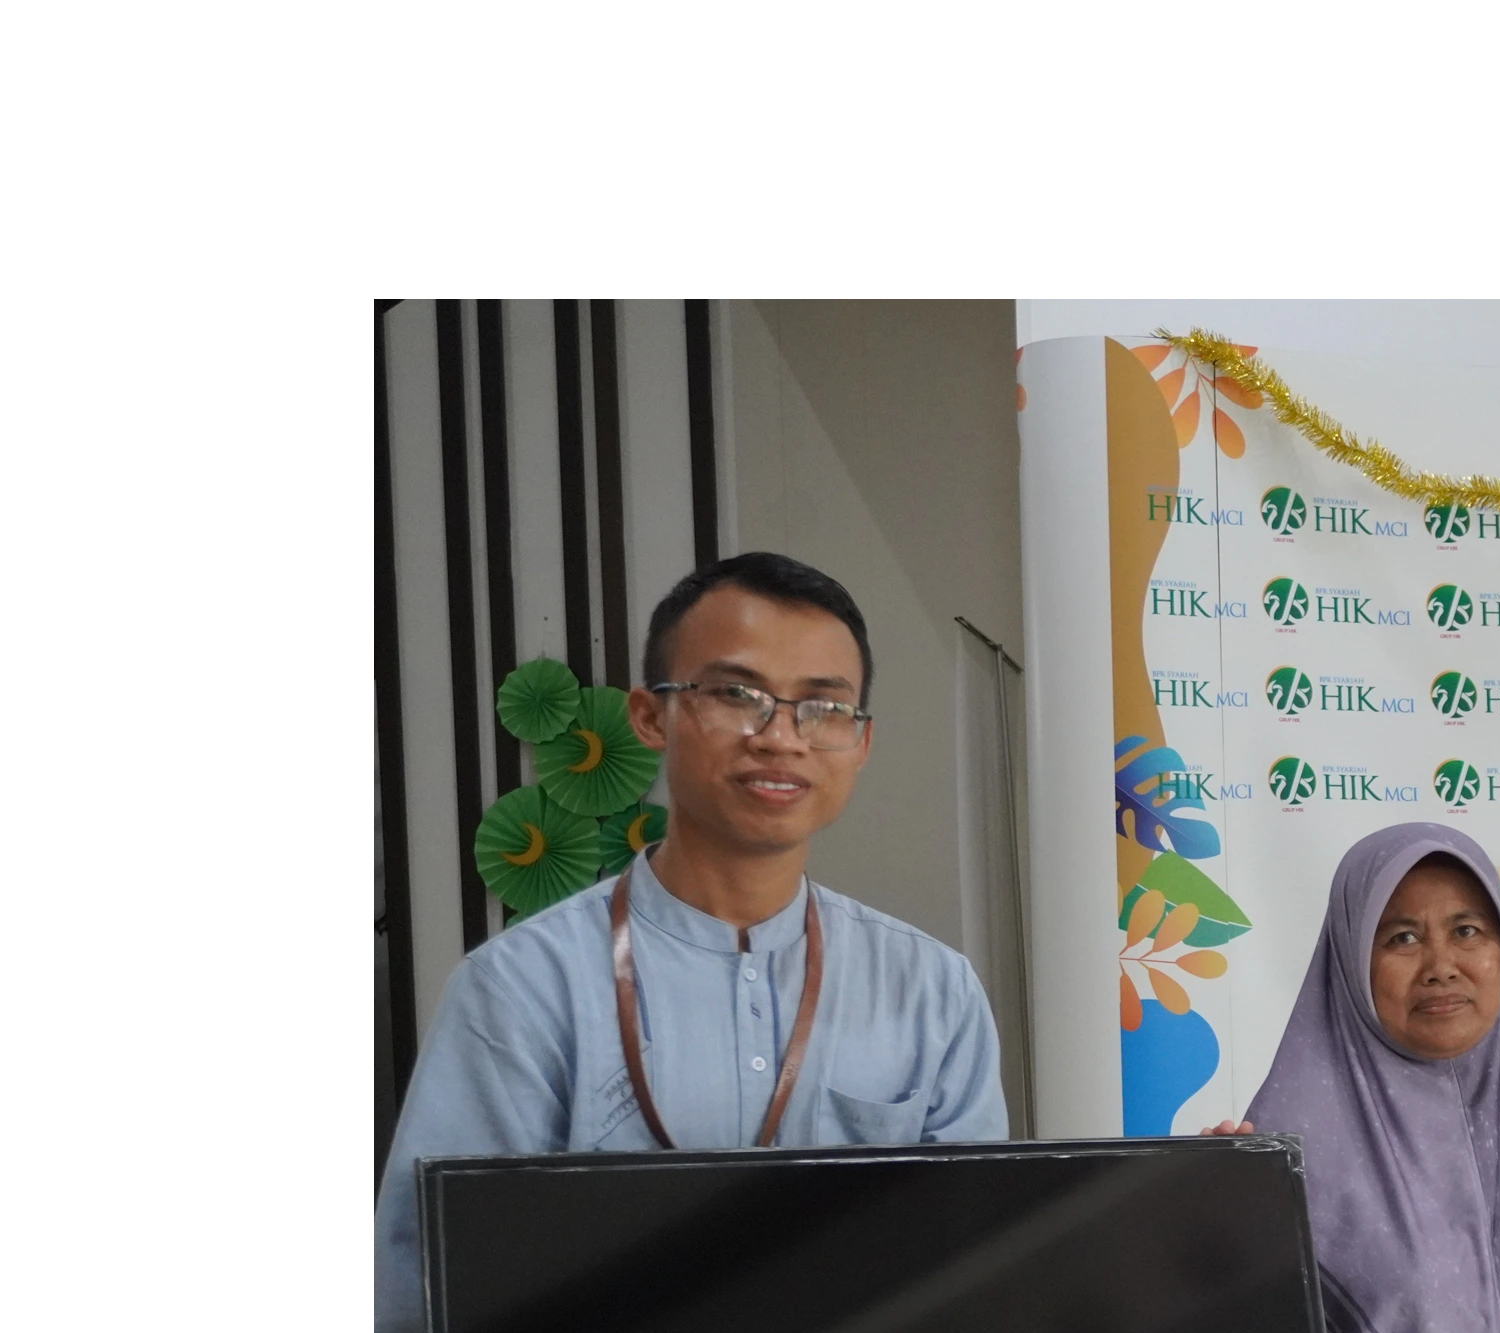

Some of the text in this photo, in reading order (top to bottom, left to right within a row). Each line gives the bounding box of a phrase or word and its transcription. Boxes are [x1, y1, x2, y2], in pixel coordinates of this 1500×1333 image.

[1314, 506, 1407, 536] HIK MCI
[1151, 588, 1246, 618] HIK MCI
[1320, 685, 1414, 713] HIK MCI
